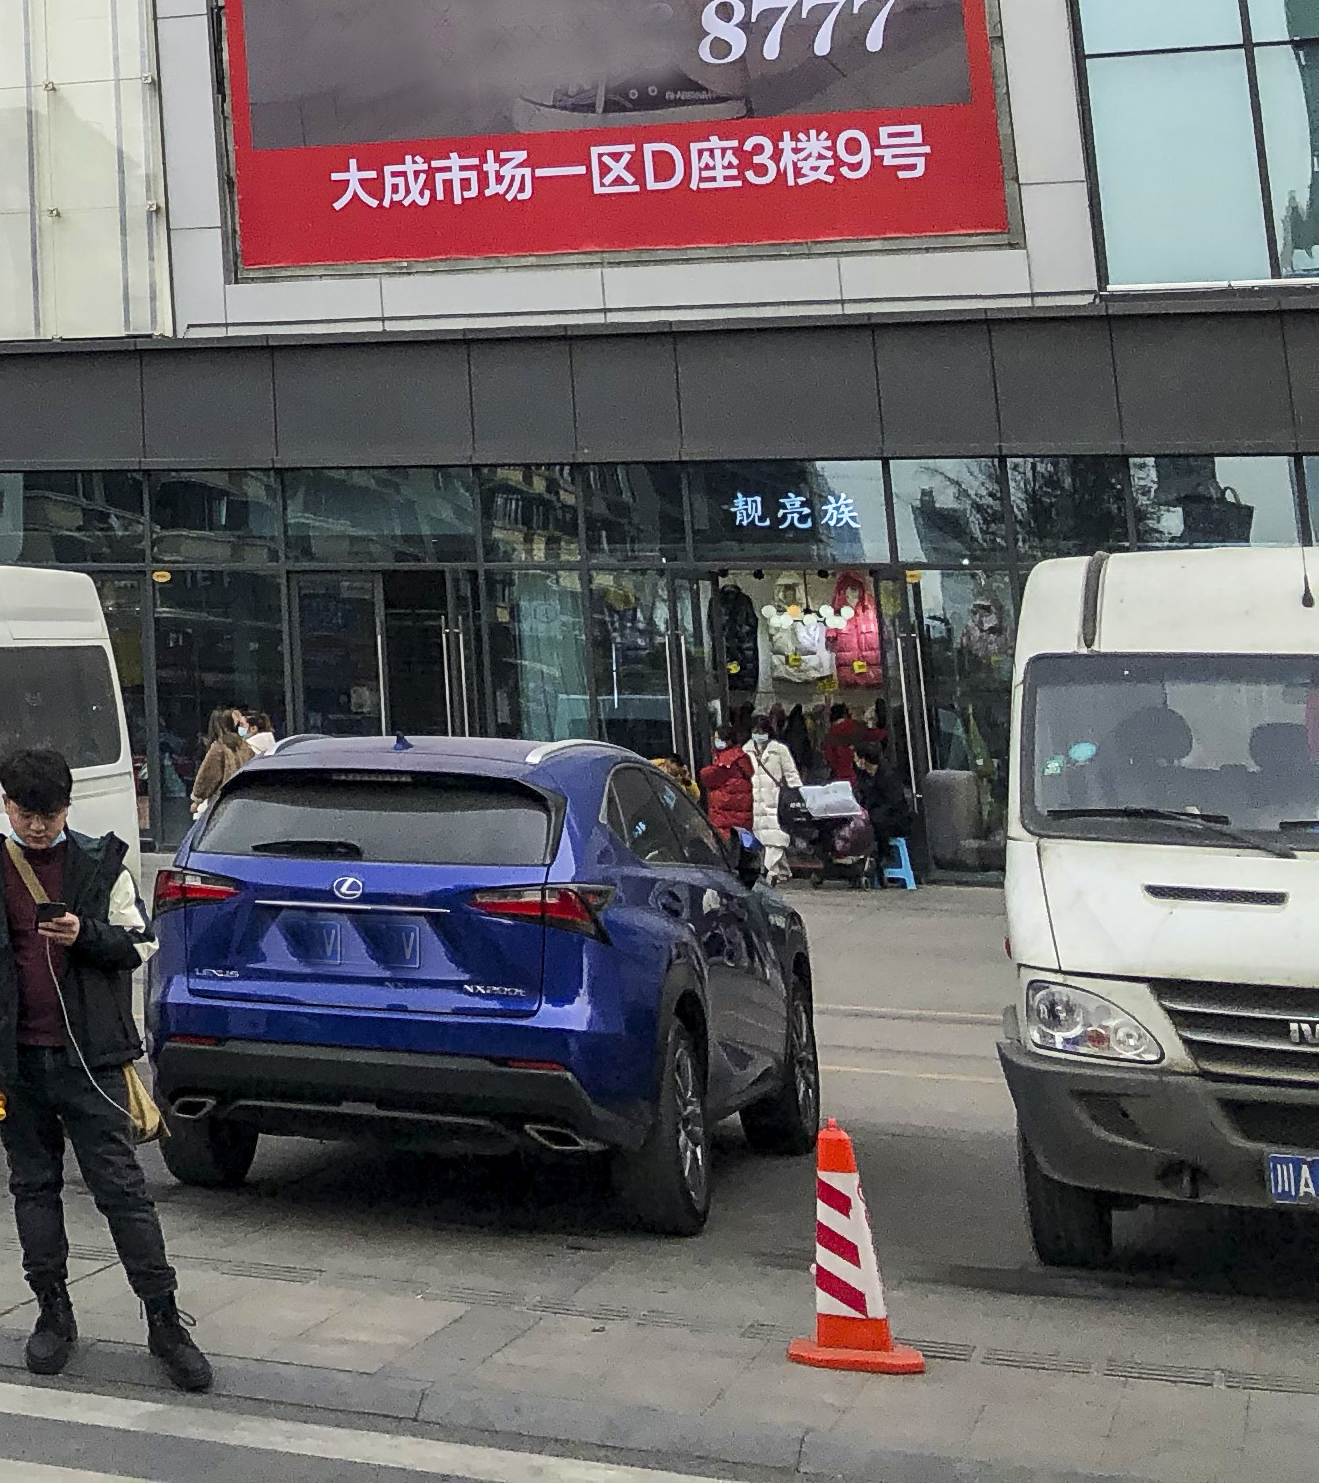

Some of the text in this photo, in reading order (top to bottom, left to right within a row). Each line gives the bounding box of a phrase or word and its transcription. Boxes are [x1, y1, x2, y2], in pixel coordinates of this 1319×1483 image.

[330, 124, 932, 211] 大成市场一区D座3楼9号
[729, 491, 862, 529] 靓亮族
